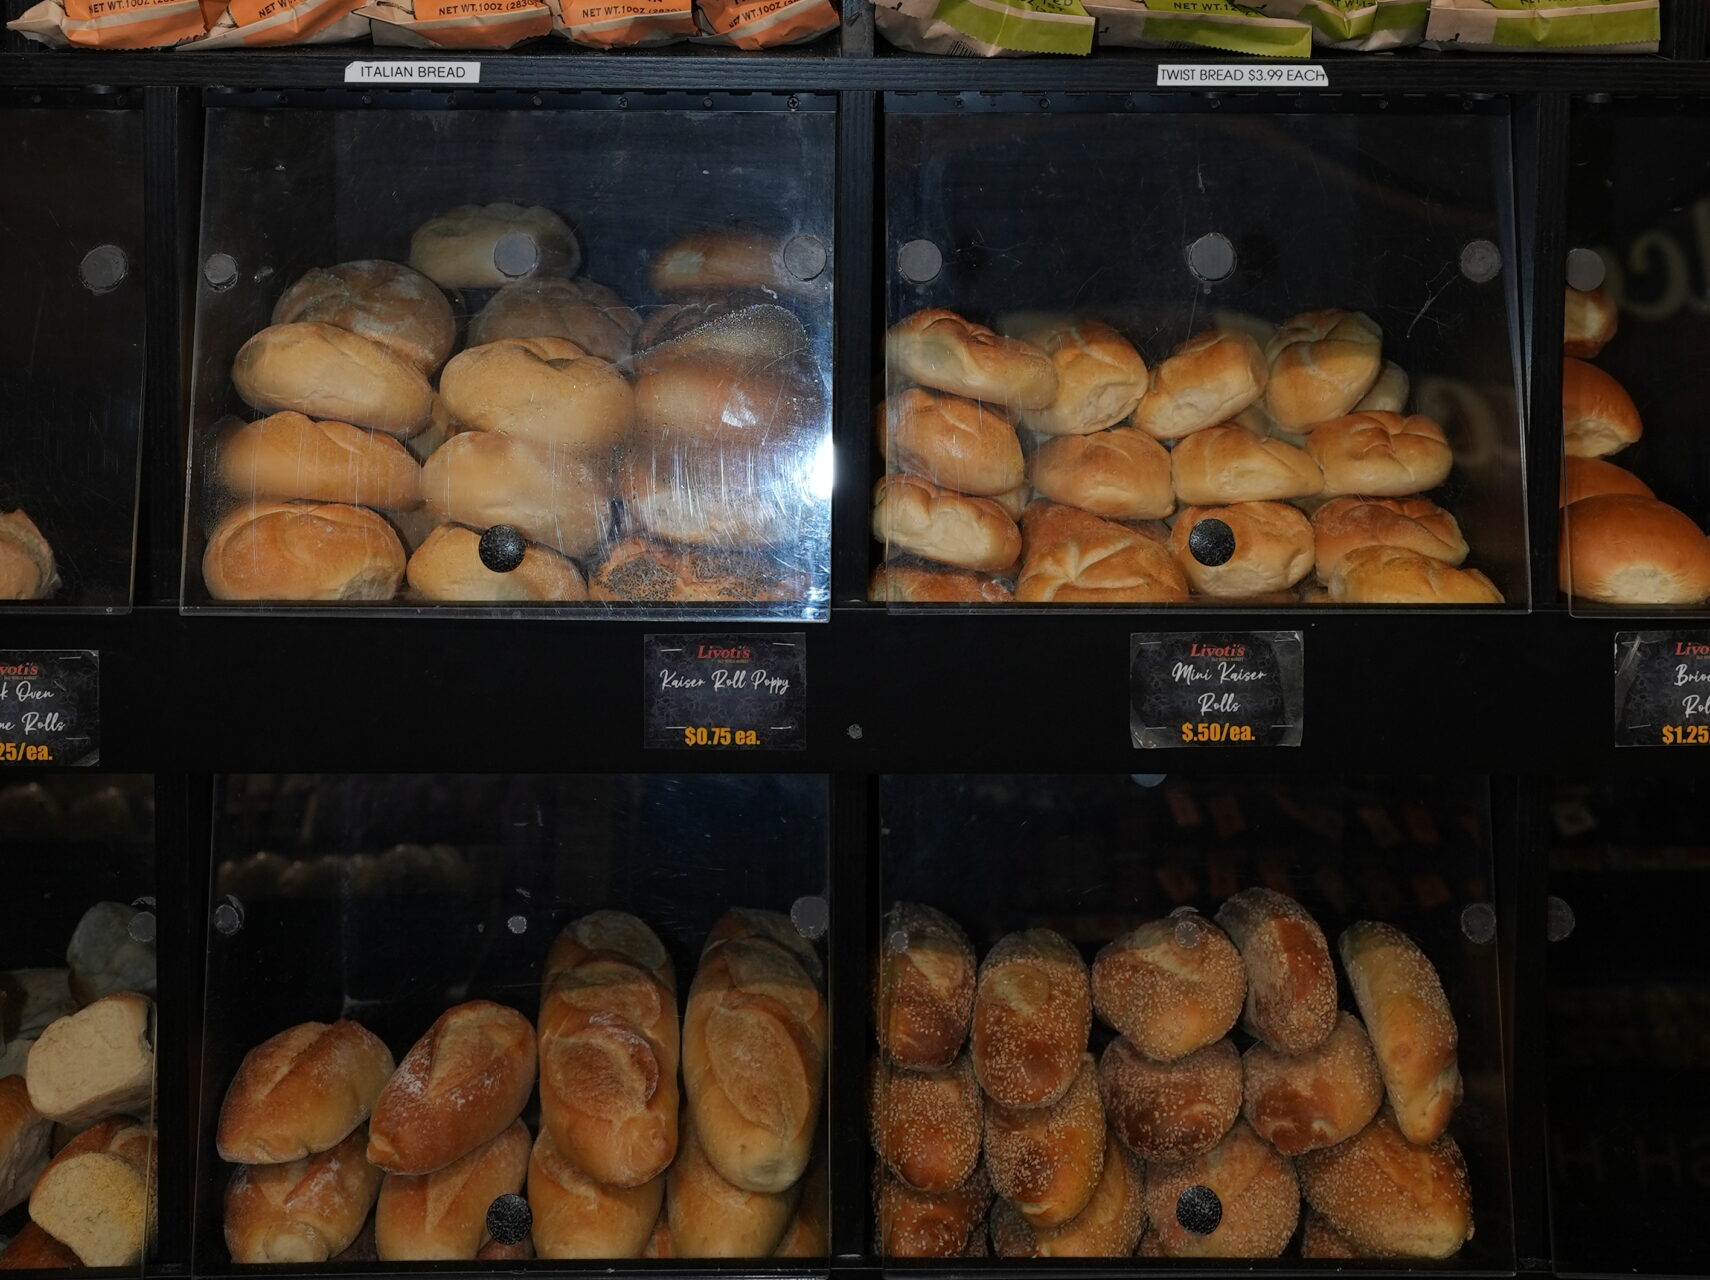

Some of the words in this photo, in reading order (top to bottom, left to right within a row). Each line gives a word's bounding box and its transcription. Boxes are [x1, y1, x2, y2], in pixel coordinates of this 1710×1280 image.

[439, 5, 458, 16] NET
[360, 66, 413, 78] ITALIAN
[418, 66, 466, 78] BREAD
[1161, 69, 1196, 80] TWIST
[1200, 69, 1244, 80] BREAD
[1248, 68, 1284, 82] $3.99
[1287, 69, 1325, 80] EACH
[660, 669, 706, 690] Kaiser
[711, 669, 746, 692] Roll
[750, 669, 790, 695] Poppy
[1172, 662, 1212, 686] Mini
[1218, 662, 1267, 684] Kaiser
[16, 680, 55, 702] Oven
[1198, 692, 1242, 716] Rolls
[21, 711, 66, 736] Rolls
[684, 726, 732, 746] $0.75
[735, 729, 760, 746] ea.
